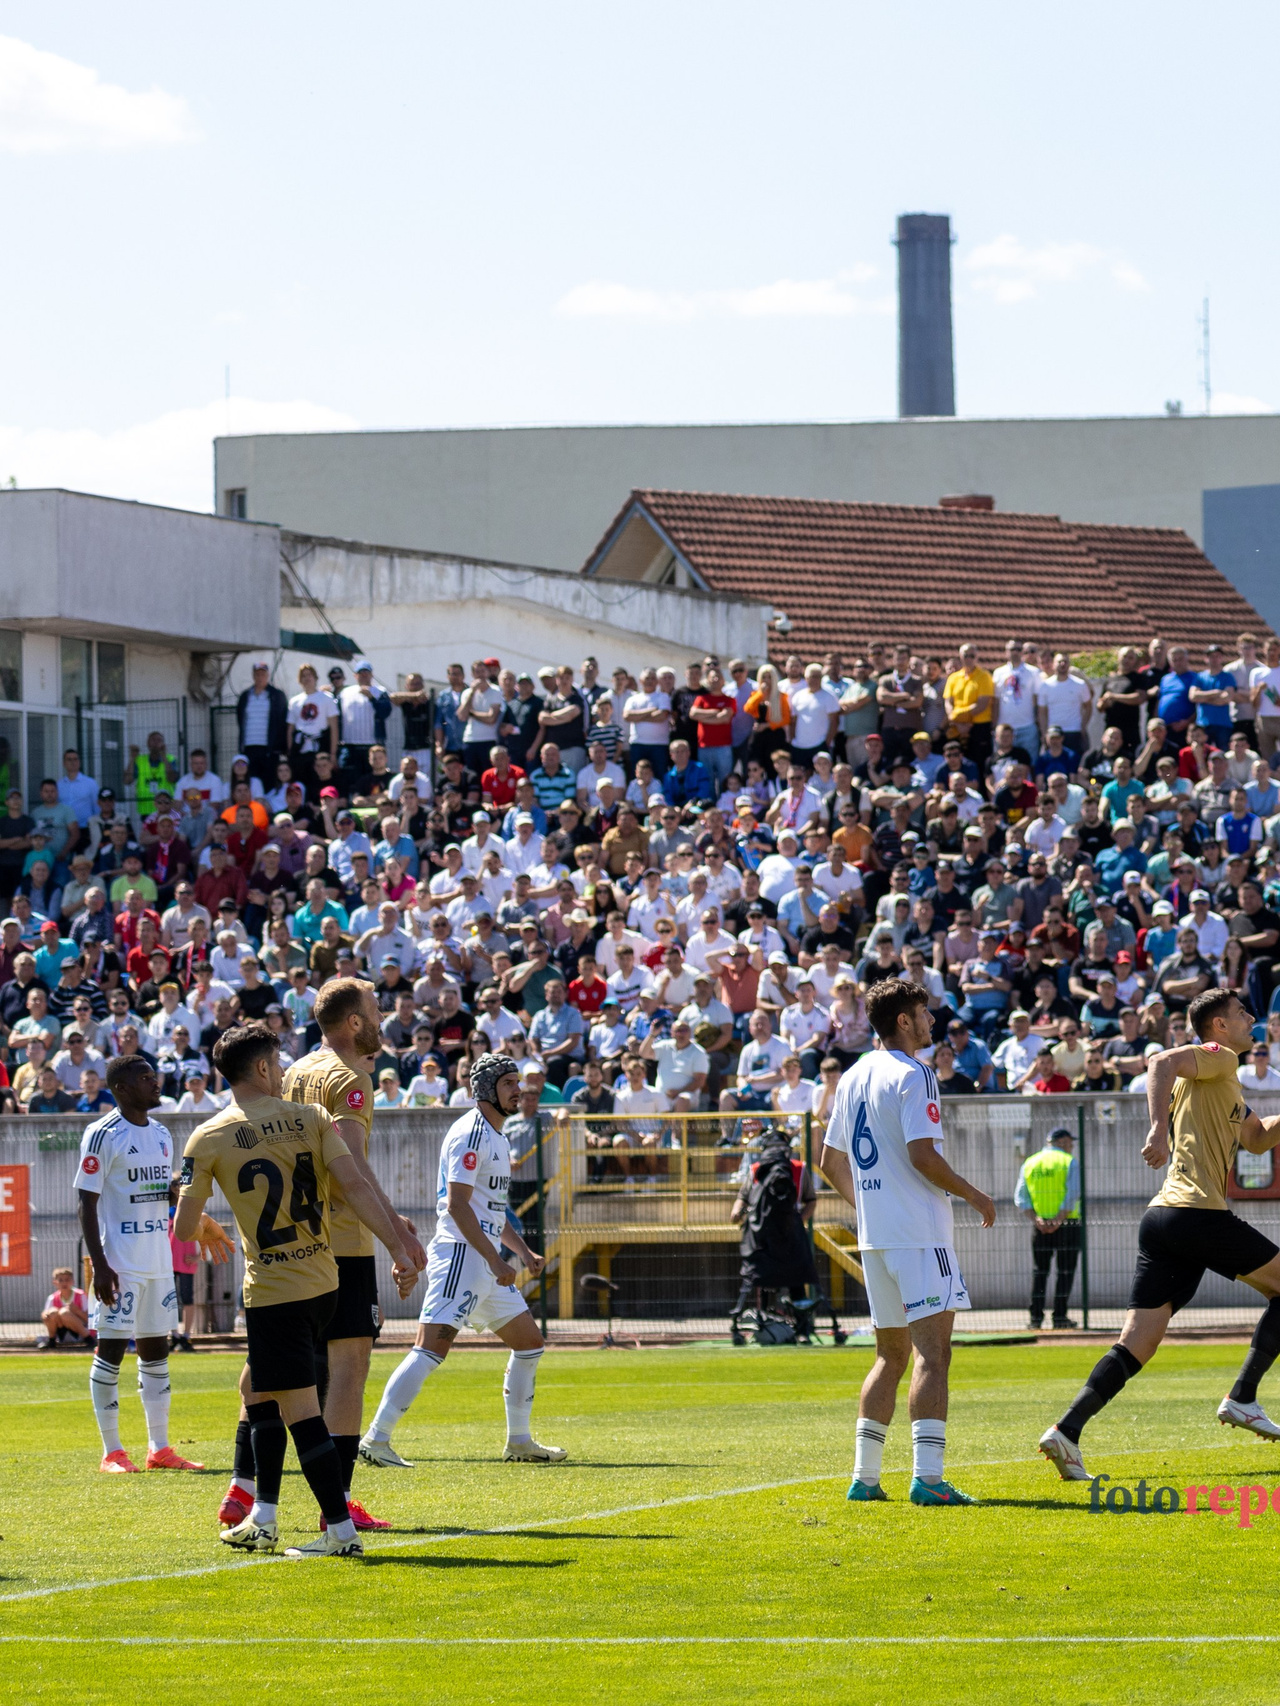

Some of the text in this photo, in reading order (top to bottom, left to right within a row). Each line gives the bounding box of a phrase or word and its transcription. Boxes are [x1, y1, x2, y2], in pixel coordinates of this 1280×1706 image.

[294, 1074, 324, 1089] HILS
[261, 1118, 304, 1135] HILS
[852, 1102, 878, 1170] 6
[128, 1165, 170, 1182] UNIBE
[237, 1151, 324, 1250] 24
[926, 1296, 940, 1305] Eco
